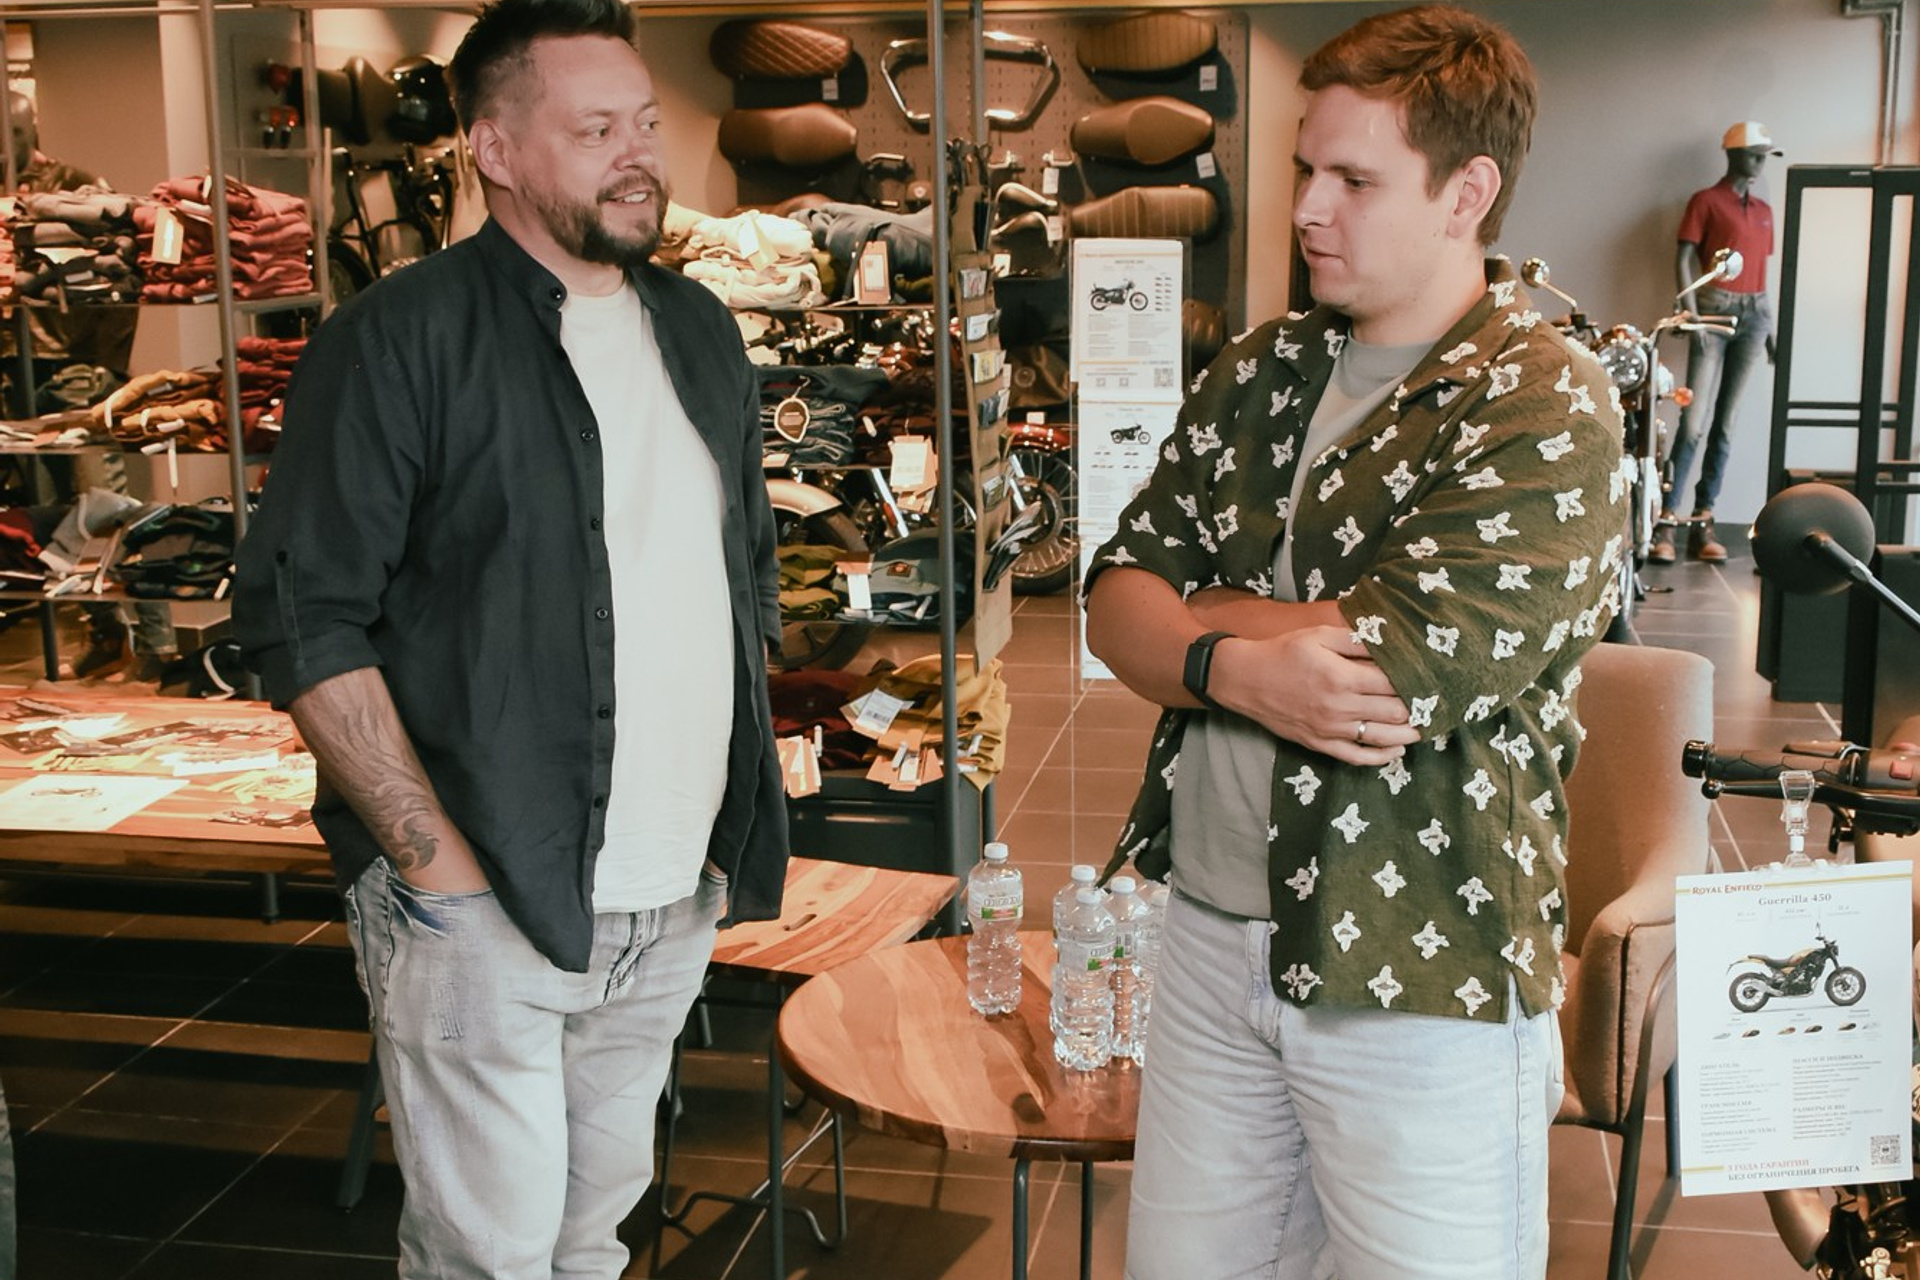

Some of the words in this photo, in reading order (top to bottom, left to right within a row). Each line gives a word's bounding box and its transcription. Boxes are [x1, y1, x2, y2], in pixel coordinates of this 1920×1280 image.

[1692, 886, 1722, 895] ROYAL
[1724, 883, 1762, 894] ENFIELD
[1758, 895, 1808, 906] Guerrilla
[1811, 893, 1832, 902] 450
[1760, 1159, 1809, 1169] ГАРАНТИИ
[1747, 1168, 1816, 1179] ОГРАНИЧЕНИЯ
[1819, 1165, 1861, 1174] ПРОБЕГА
